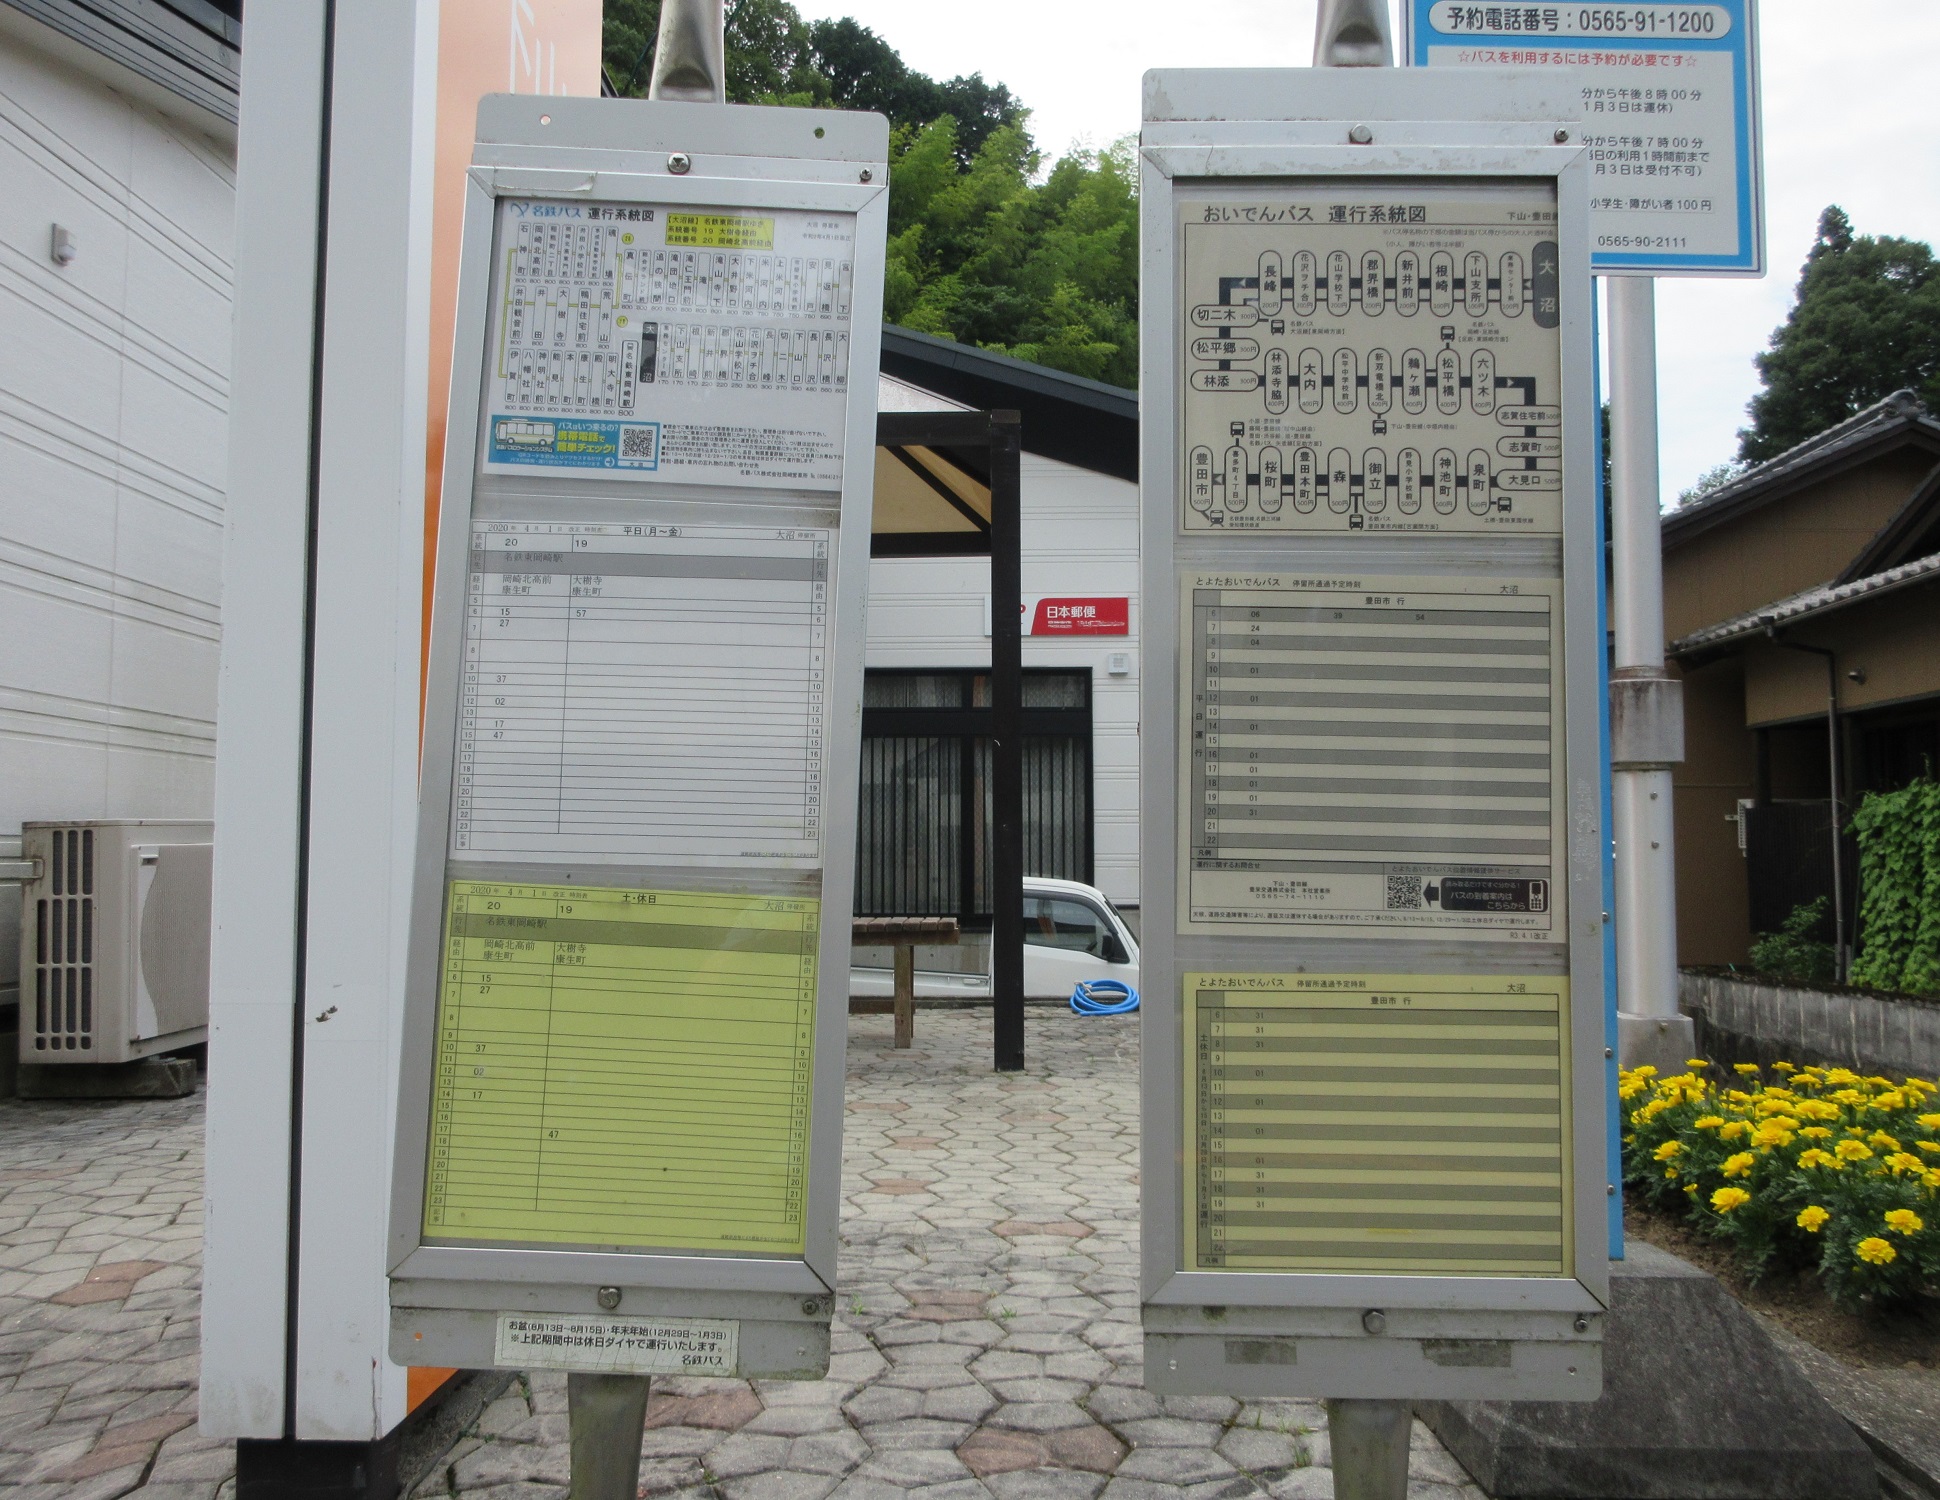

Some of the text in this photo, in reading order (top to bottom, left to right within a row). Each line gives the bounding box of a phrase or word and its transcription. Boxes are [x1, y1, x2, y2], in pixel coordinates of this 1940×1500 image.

[532, 205, 655, 222] 名鉄バス 運行系統図
[1203, 205, 1427, 223] おいでんバス 運行系統図
[1598, 235, 1687, 248] 0565-90-2111
[1264, 265, 1277, 292] 長峰
[1334, 253, 1343, 301] 花山学校下
[1366, 259, 1378, 298] 郡界橋
[1402, 259, 1413, 299] 新井前
[1435, 264, 1448, 292] 根崎
[1470, 255, 1482, 303] 下山支所
[1539, 259, 1555, 313] 大沼
[1196, 309, 1236, 321] 切二木
[1196, 341, 1236, 354] 松平郷
[1203, 375, 1230, 387] 林添
[1271, 352, 1282, 400] 林添寺脇
[1303, 363, 1316, 391] 大内
[1442, 357, 1455, 397] 松平橋
[1477, 358, 1489, 397] 六ツ木
[1501, 411, 1546, 421] 志賀住宅前
[1508, 442, 1542, 453] 志賀町
[1195, 452, 1209, 496] 豊田市
[1264, 460, 1278, 489] 桜町
[1299, 451, 1311, 499] 豊田本町
[1333, 470, 1347, 483] 森
[1368, 462, 1382, 490] 御立
[1439, 457, 1452, 497] 神池町
[1472, 464, 1486, 492] 泉町
[1508, 475, 1541, 486] 大見口
[776, 530, 795, 541] 大沼
[504, 538, 588, 548] 20 19
[502, 574, 603, 586] 岡崎北高前 大樹寺
[1196, 577, 1281, 587] とよたおいでんバス
[1500, 585, 1519, 594] 大沼
[500, 608, 587, 618] 15 57
[1047, 605, 1096, 619] 日本郵便
[499, 619, 510, 627] 27
[1250, 638, 1260, 646] 04
[496, 675, 507, 683] 37
[494, 697, 506, 706] 02
[494, 720, 505, 728] 17
[493, 731, 504, 740] 47
[487, 901, 573, 914] 20 19
[622, 893, 784, 911] 土・休日 大沼
[484, 939, 586, 953] 岡崎北高前 大樹寺
[481, 974, 492, 983] 15
[479, 985, 491, 994] 27
[1199, 977, 1285, 987] とよたおいでんバス
[1507, 983, 1526, 993] 大沼
[1255, 1011, 1264, 1019] 31
[1255, 1026, 1264, 1034] 31
[475, 1044, 486, 1052] 37
[1255, 1041, 1264, 1049] 31
[473, 1067, 485, 1076] 02
[1255, 1069, 1264, 1077] 01
[472, 1091, 483, 1099] 17
[1255, 1098, 1264, 1106] 01
[548, 1130, 559, 1139] 47
[1255, 1128, 1264, 1136] 01
[1256, 1157, 1265, 1165] 01
[1256, 1171, 1265, 1179] 31
[1256, 1186, 1265, 1194] 31
[1256, 1201, 1265, 1209] 31
[681, 1354, 724, 1367] 名鉄バス
